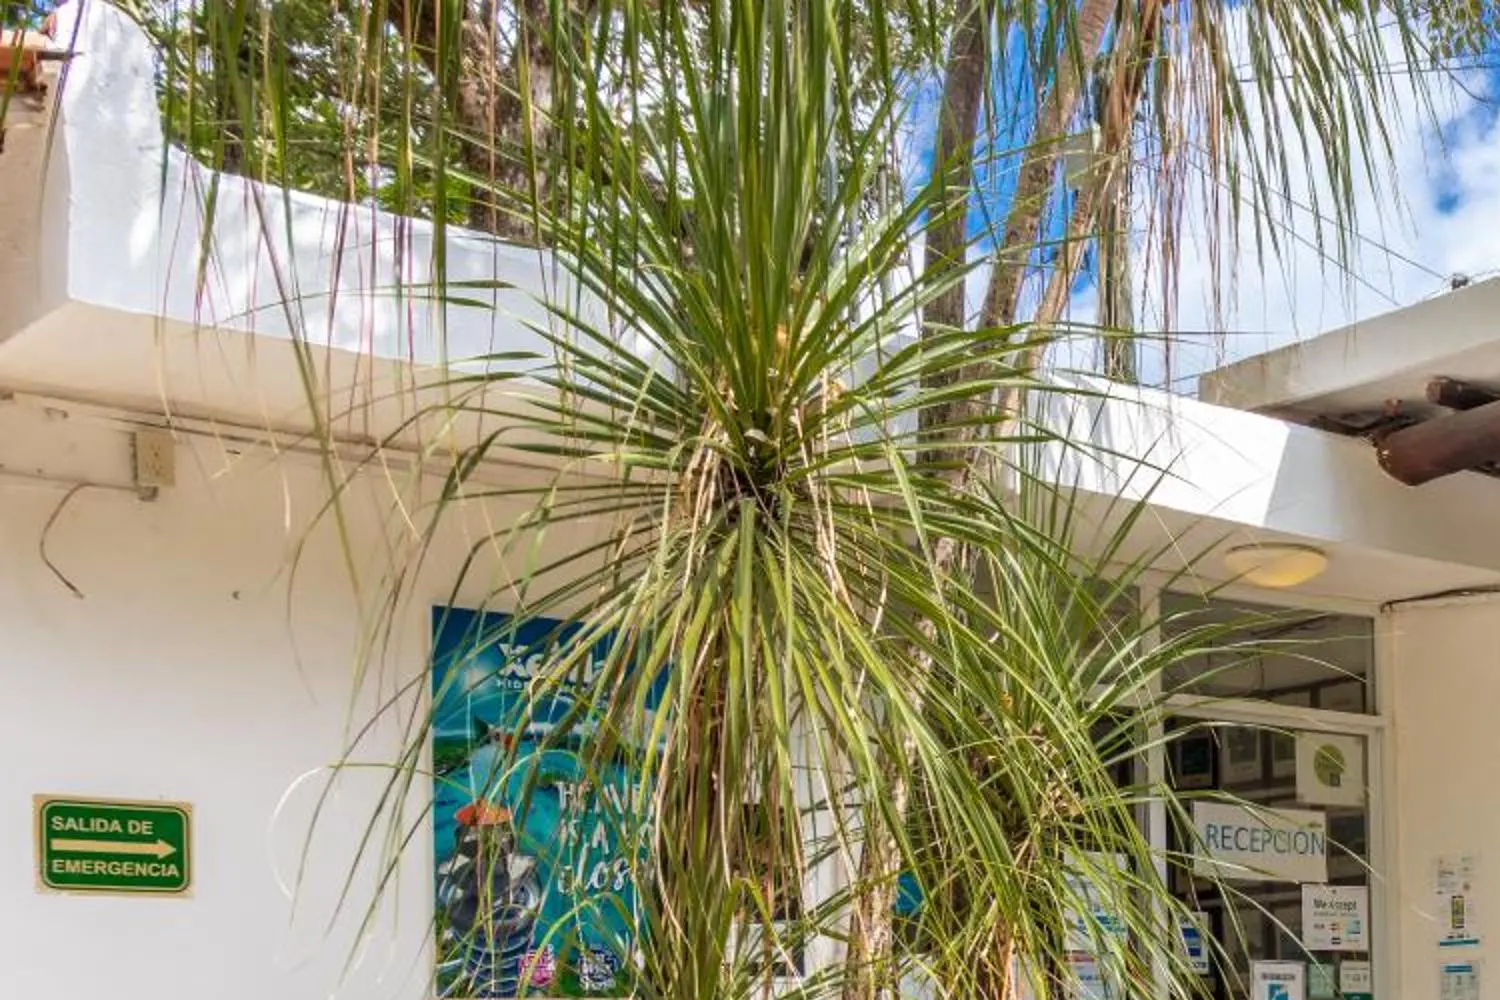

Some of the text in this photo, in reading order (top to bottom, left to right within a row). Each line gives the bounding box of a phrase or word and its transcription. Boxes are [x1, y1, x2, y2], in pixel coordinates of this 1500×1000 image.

[51, 815, 154, 835] SALIDA DE
[52, 859, 180, 878] EMERGENCIA
